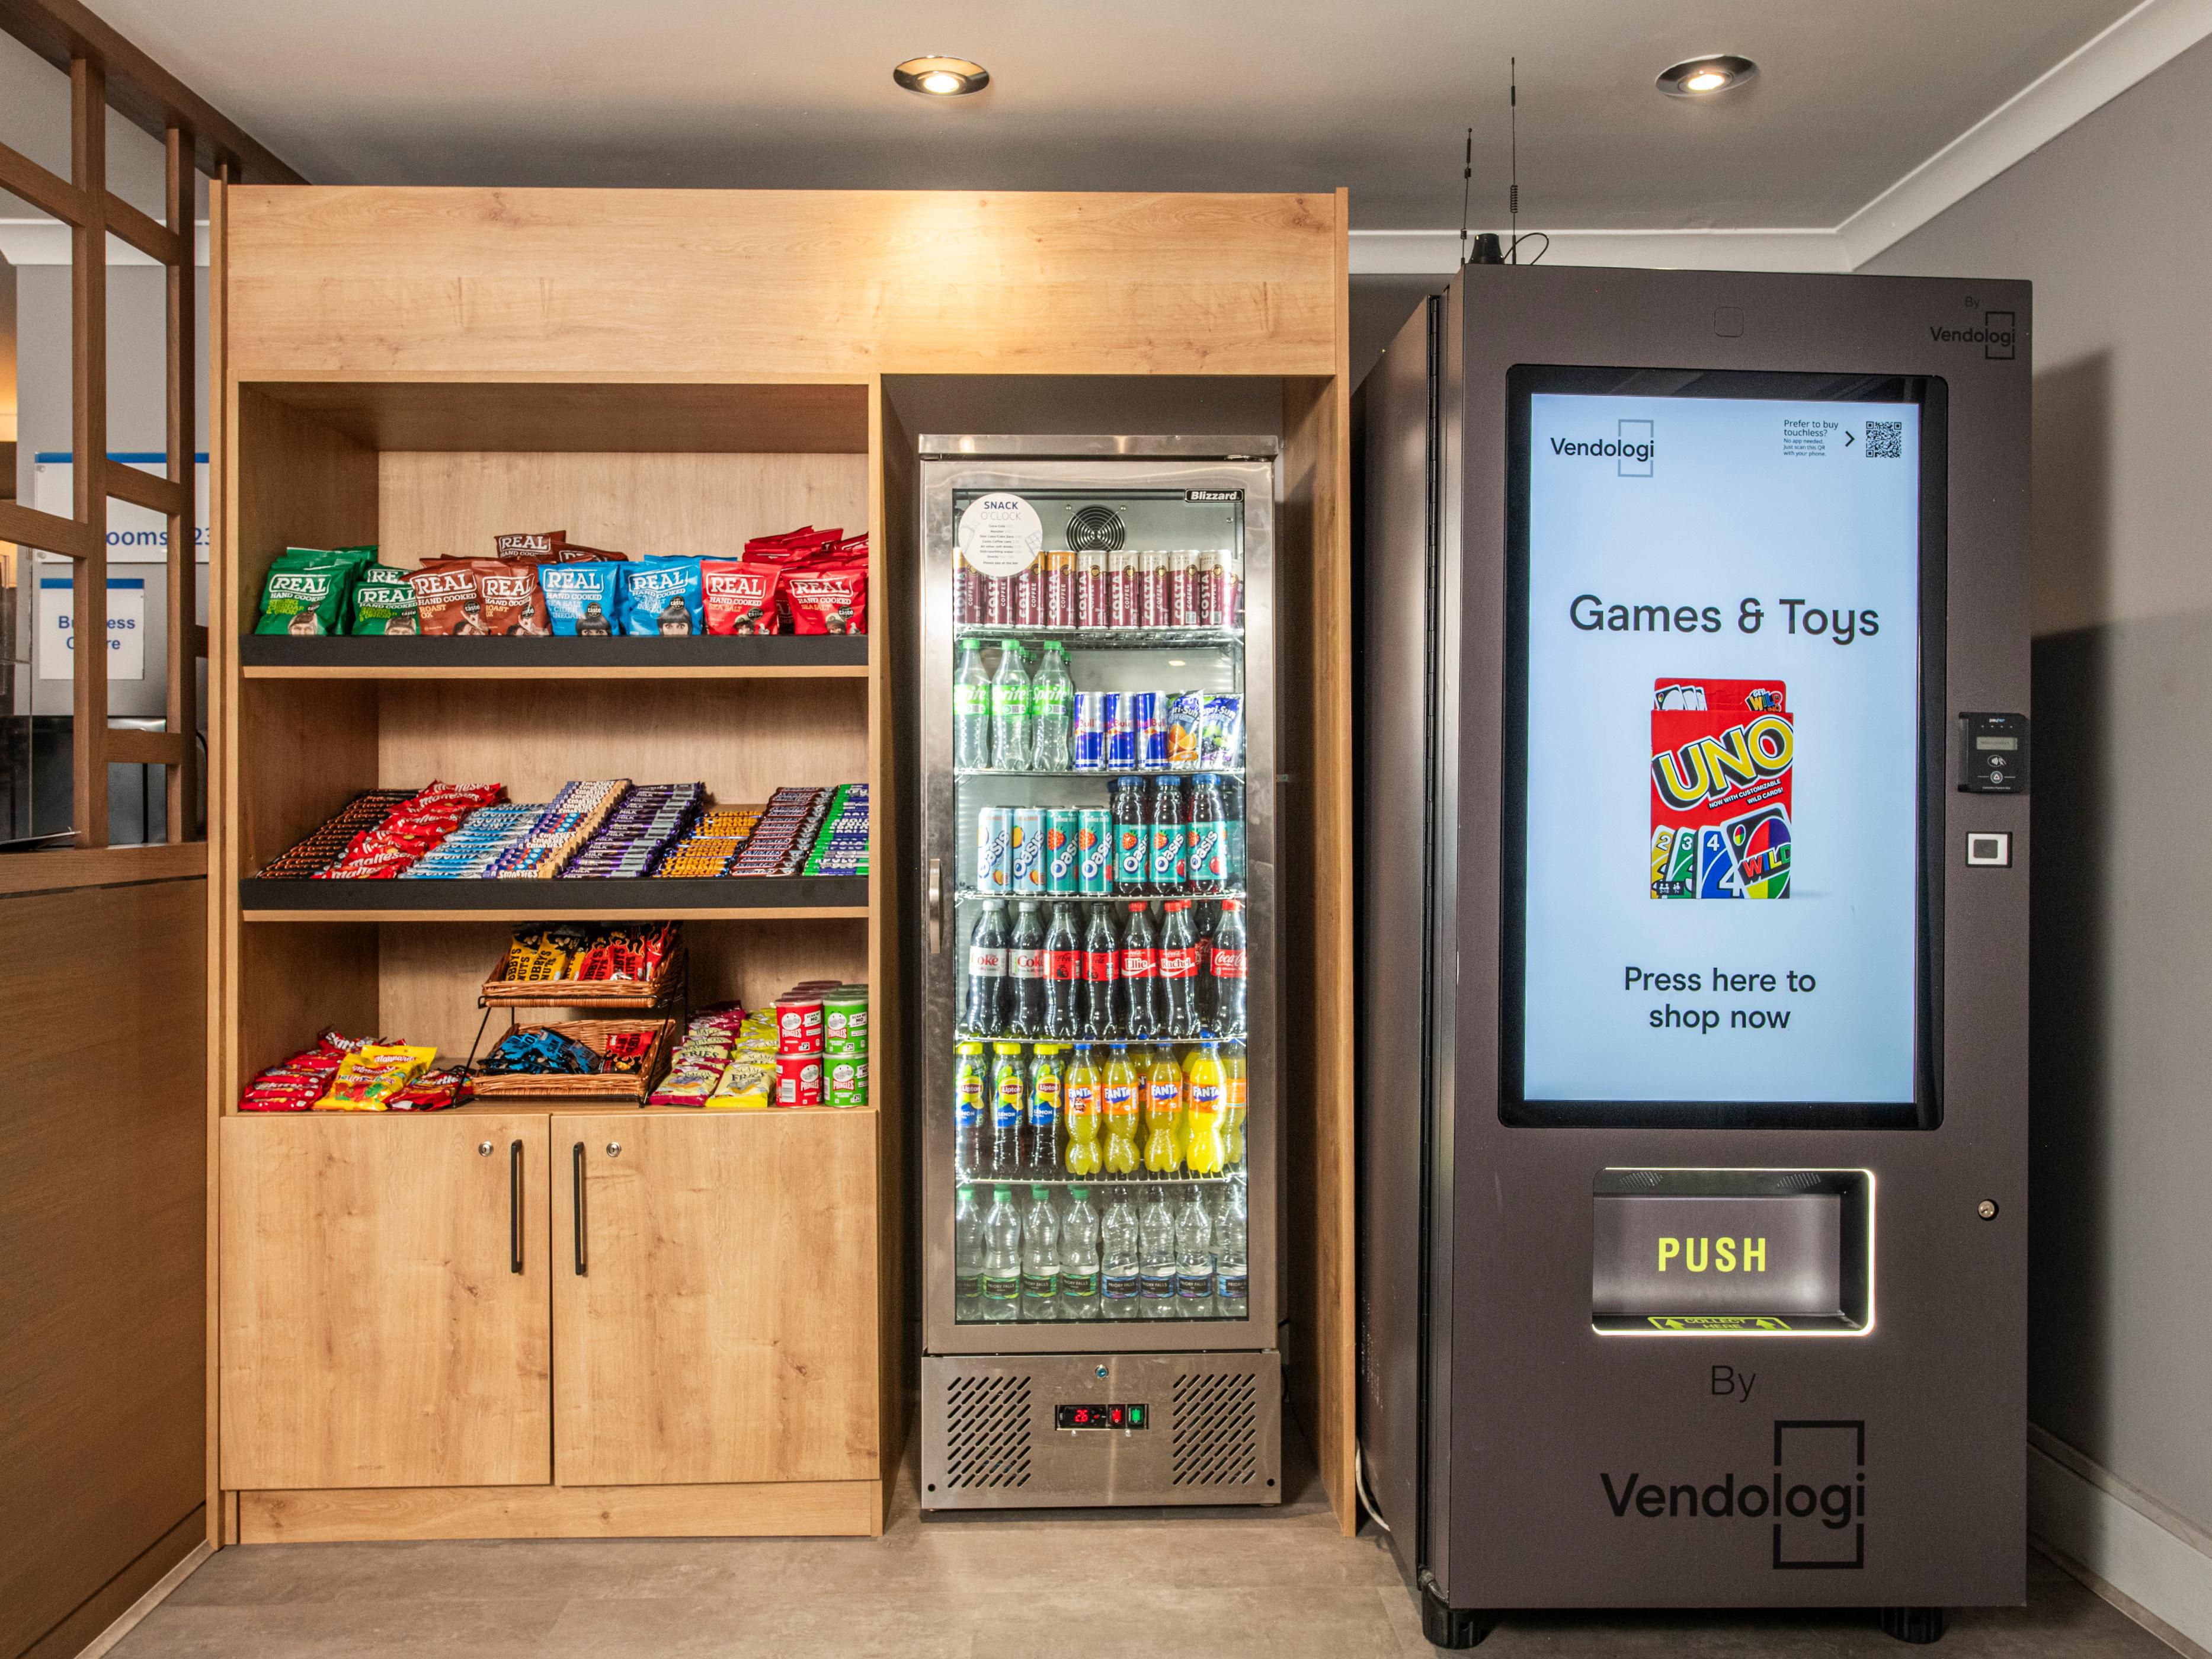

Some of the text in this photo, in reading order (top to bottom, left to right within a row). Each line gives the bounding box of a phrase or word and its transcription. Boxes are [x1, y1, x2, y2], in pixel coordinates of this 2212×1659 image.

[1965, 297, 1980, 309] By
[1930, 326, 2015, 347] Vendologi
[1784, 419, 1810, 428] Prefer
[1823, 421, 1839, 430] buy
[1784, 428, 1827, 437] touchless?
[1550, 437, 1654, 462] Vendologi
[1190, 491, 1238, 500] Blizzard
[984, 501, 1019, 510] SNACK
[981, 511, 1022, 521] O'CLOCK
[106, 530, 168, 546] ooms
[501, 535, 548, 550] REAL
[273, 577, 326, 594] REAL
[415, 574, 473, 595] REAL
[486, 577, 532, 596] REAL
[547, 571, 600, 590] REAL
[633, 571, 684, 591] REAL
[711, 577, 762, 595] REAL
[795, 580, 850, 594] REAL
[363, 588, 416, 603] REAL
[418, 592, 477, 606] HAND COOKED
[657, 588, 686, 598] COOKED
[1019, 572, 1029, 619] COSTA
[1079, 574, 1088, 620] COSTA
[1112, 574, 1121, 620] COSTA
[1144, 574, 1152, 620] COSTA
[1174, 574, 1183, 620] COSTA
[1201, 574, 1210, 619] COSTA
[419, 604, 447, 613] ROAST
[485, 598, 508, 606] HAND
[734, 598, 763, 607] COOKED
[1570, 594, 1880, 645] Games & Toys
[1032, 686, 1067, 703] Sprite
[1656, 716, 1793, 806] UNO
[1709, 779, 1781, 809] NOW WITH CUSTOMIZABLE
[1747, 787, 1784, 804] WILD CARDS!
[1190, 831, 1218, 870] Oasis
[1656, 835, 1671, 851] 2
[1682, 836, 1693, 851] 3
[1707, 834, 1720, 851] 4
[1013, 830, 1045, 878] Oasis
[1081, 832, 1113, 878] Oasis
[1155, 833, 1184, 872] Oasis
[1743, 844, 1791, 878] WILD
[499, 870, 539, 878] SMARTIES
[1125, 958, 1147, 969] Ellie
[1161, 958, 1191, 969] Rachel
[1625, 966, 1817, 992] Press here to
[1649, 1004, 1791, 1035] shop now
[834, 1080, 854, 1090] PRINGLES
[1068, 1087, 1093, 1098] FANTA
[1104, 1087, 1131, 1098] FANTA
[1151, 1084, 1177, 1097] FANTA
[1192, 1086, 1219, 1098] FANTA
[1659, 1237, 1766, 1272] PUSH
[1712, 1365, 1756, 1403] By
[1599, 1472, 1865, 1530] Vendologi
